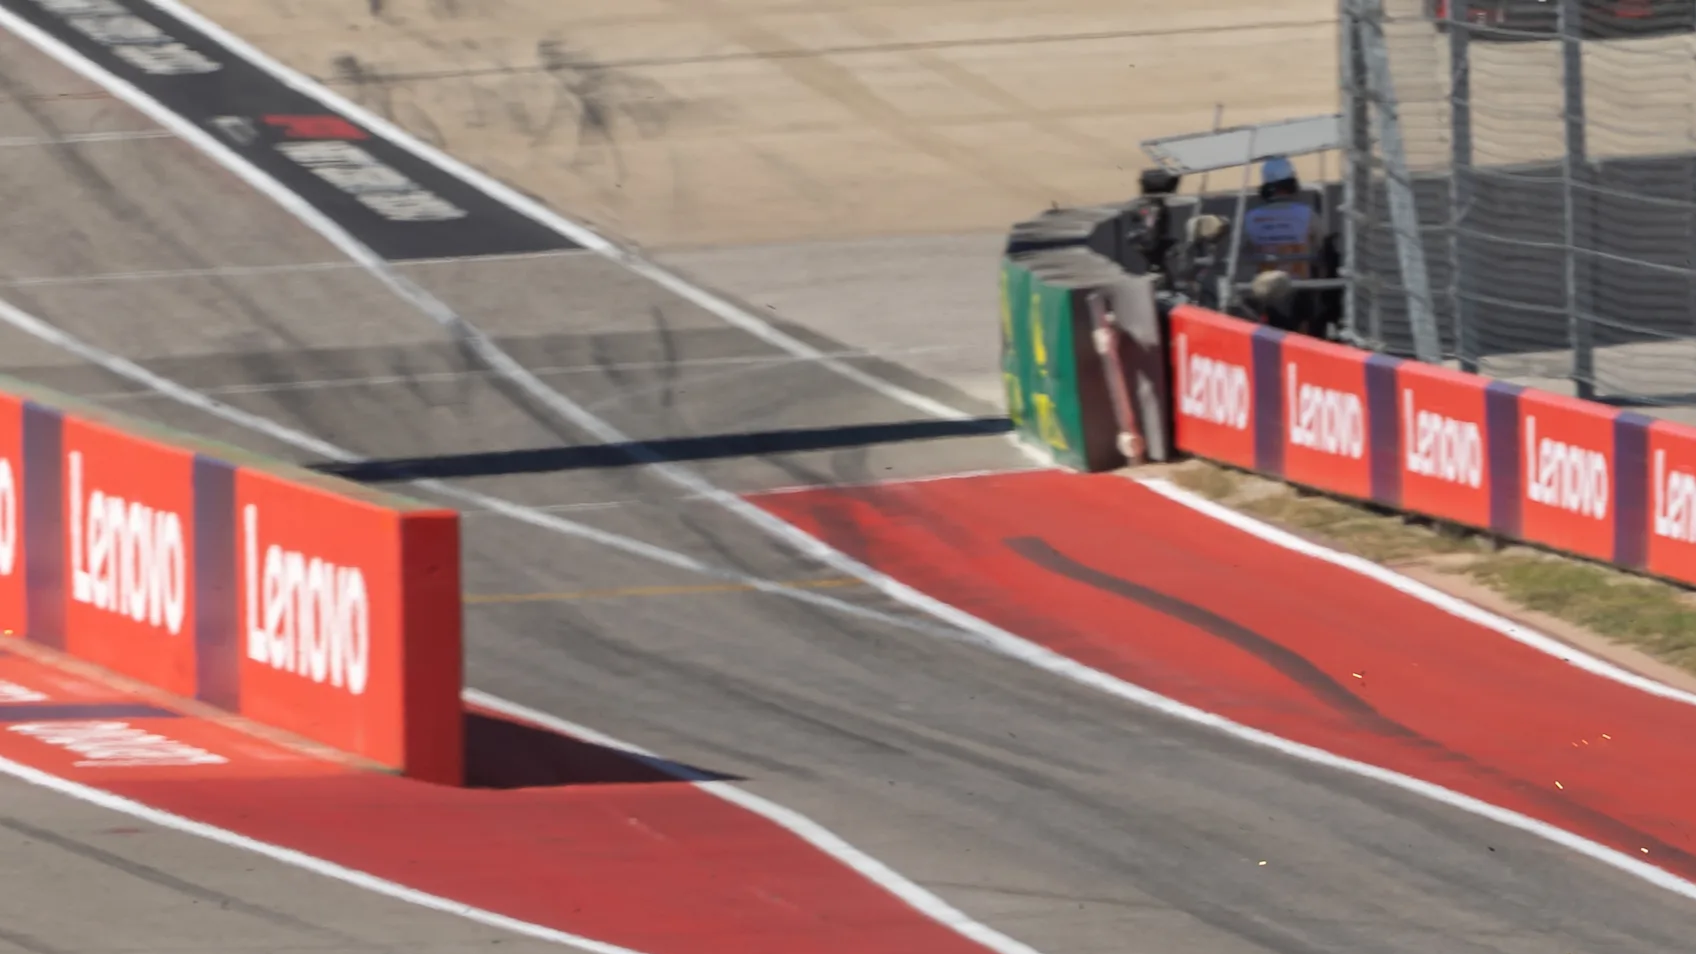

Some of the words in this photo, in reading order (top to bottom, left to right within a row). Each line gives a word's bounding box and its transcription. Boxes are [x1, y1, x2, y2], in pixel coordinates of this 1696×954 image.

[1180, 336, 1249, 429] Lenovo
[1288, 363, 1364, 459] Lenovo
[1404, 389, 1483, 488] Lenovo
[1526, 415, 1608, 520] Lenovo
[67, 450, 186, 635] Lenovo
[243, 503, 369, 695] Lenovo
